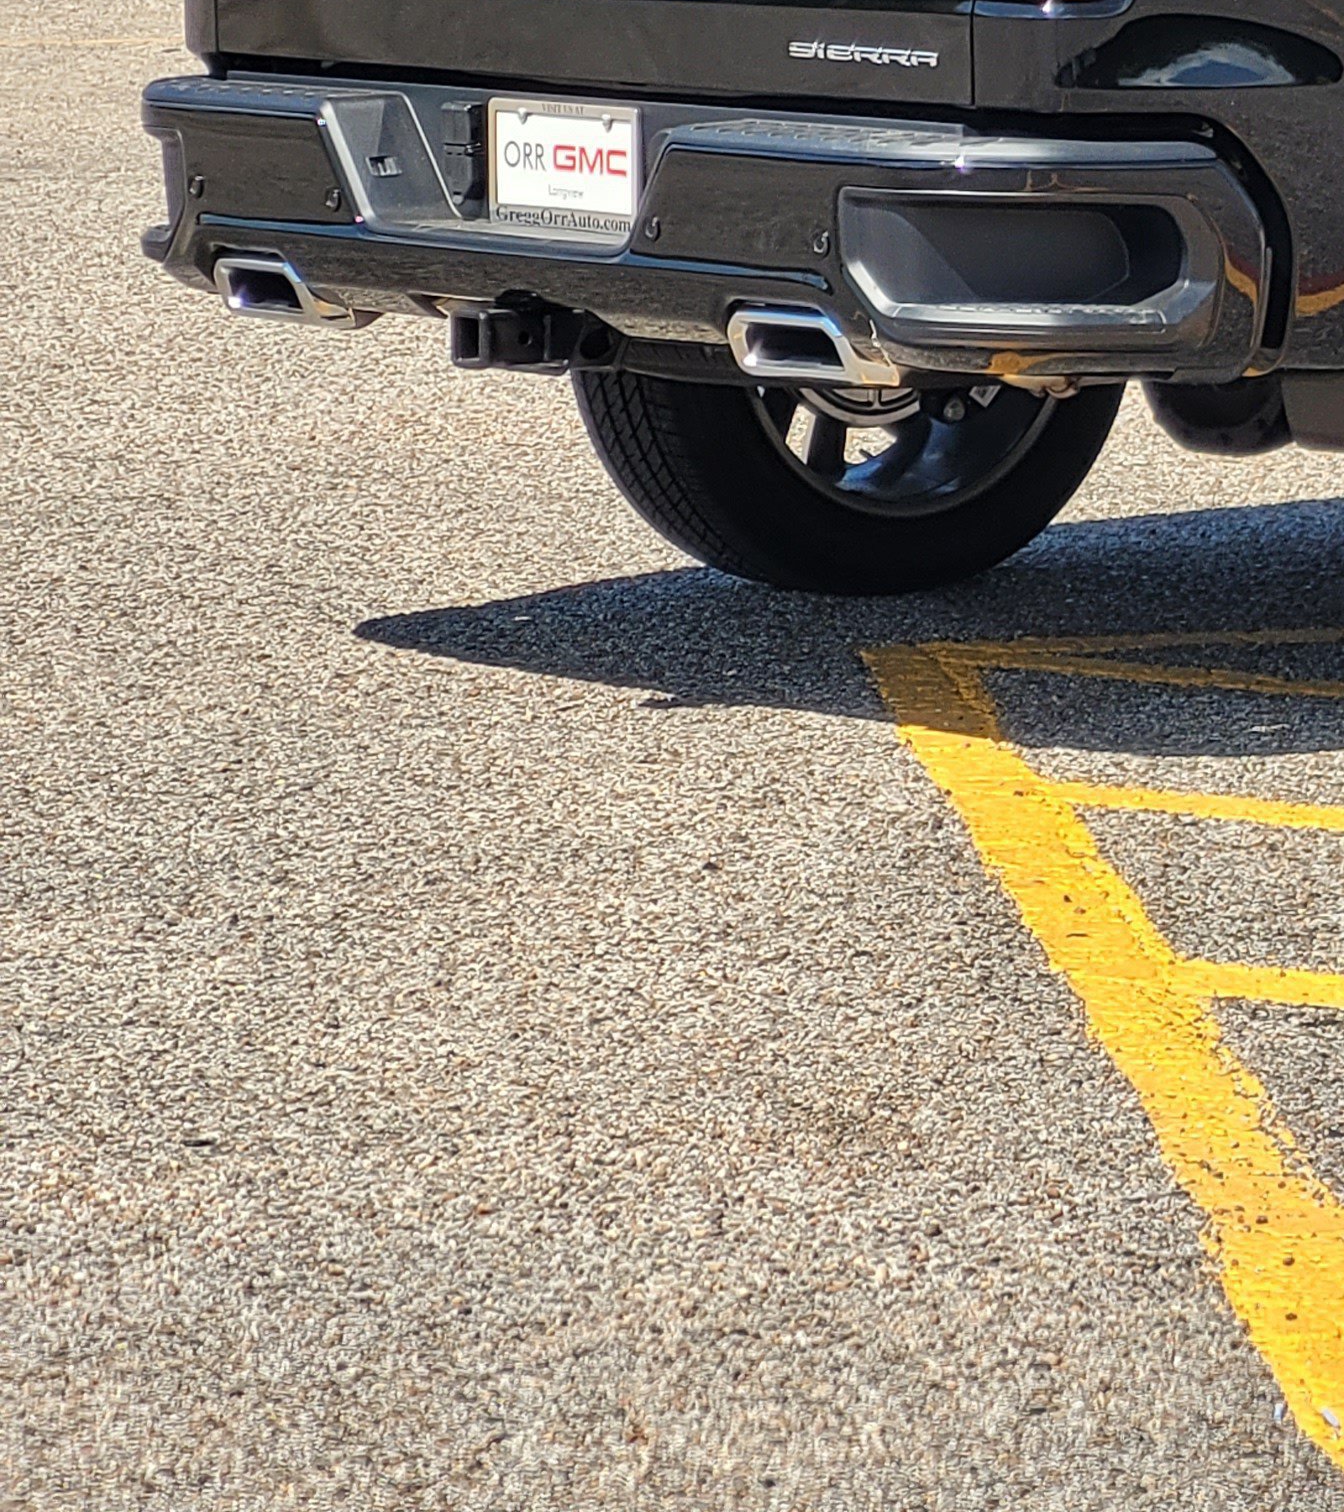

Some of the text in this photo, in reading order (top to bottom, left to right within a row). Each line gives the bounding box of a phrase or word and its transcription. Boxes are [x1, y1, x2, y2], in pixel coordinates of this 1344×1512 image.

[788, 41, 939, 68] SIERRA
[504, 140, 628, 178] ORR GMC
[496, 205, 632, 233] GreggOrrAuto.com
